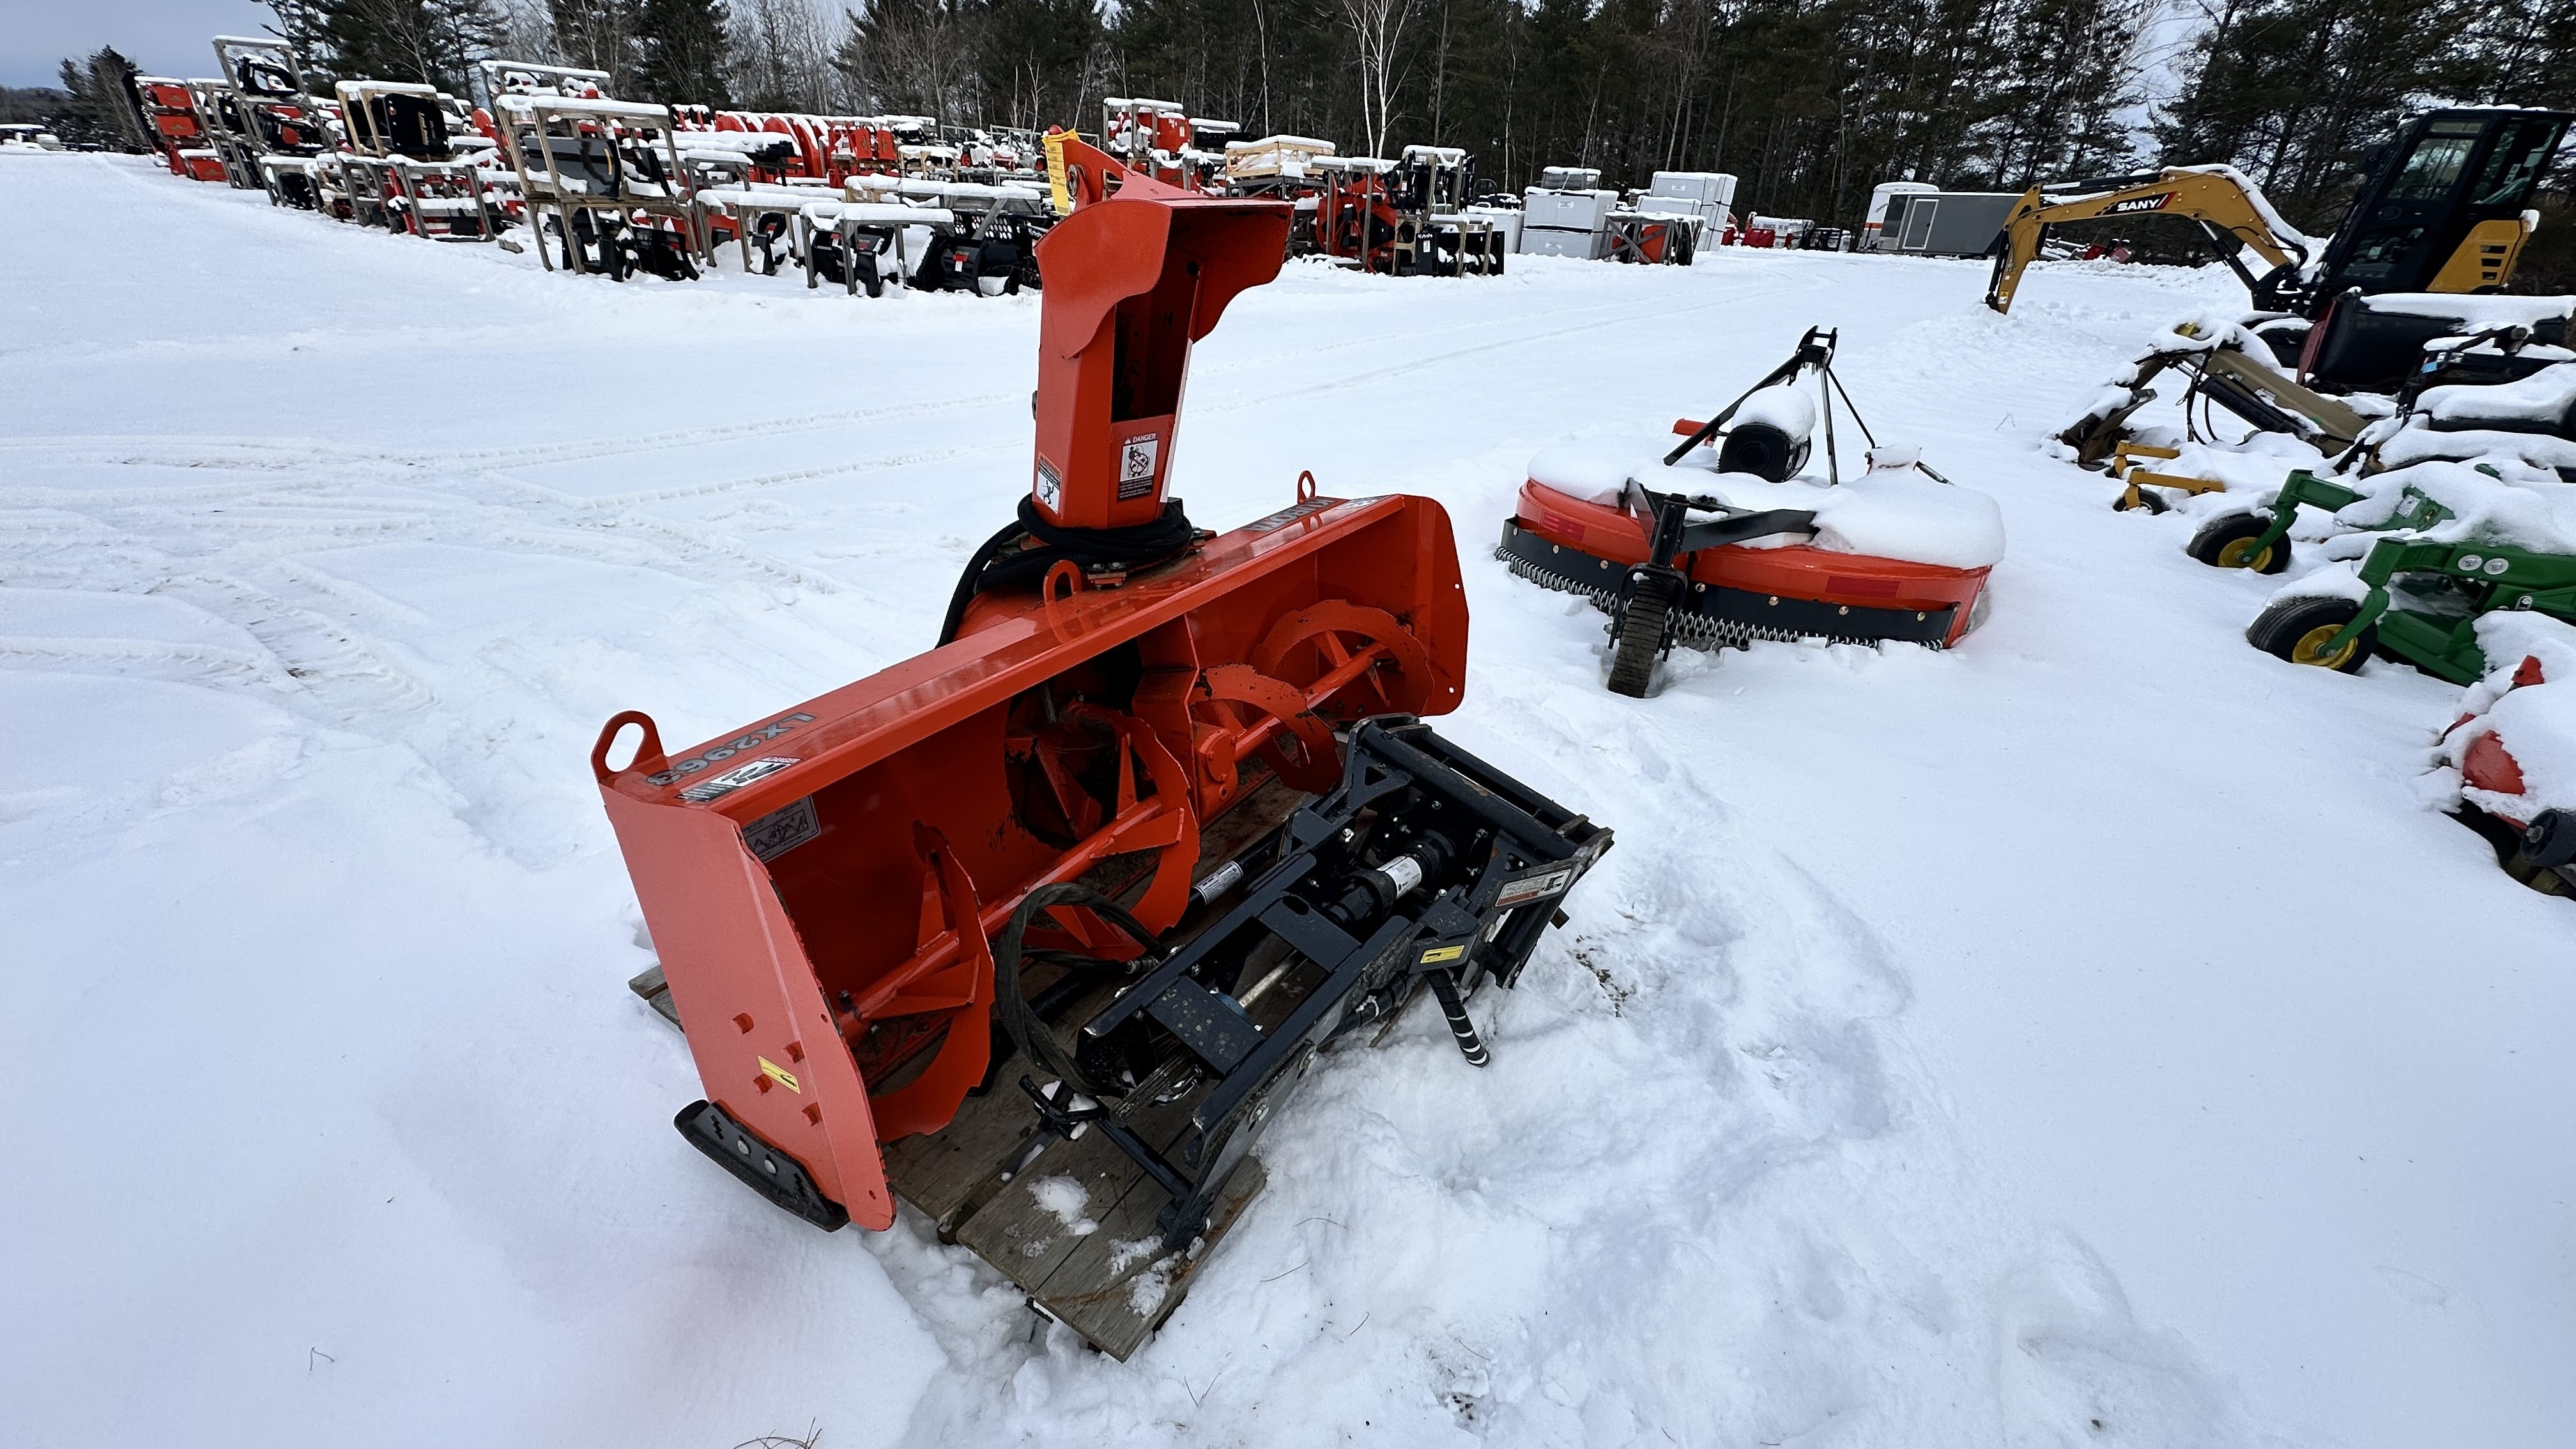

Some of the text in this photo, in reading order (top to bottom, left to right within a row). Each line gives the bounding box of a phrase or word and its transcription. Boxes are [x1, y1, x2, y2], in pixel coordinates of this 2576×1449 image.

[2117, 198, 2160, 211] SANY
[1133, 433, 1156, 443] DANGER
[646, 712, 816, 786] LX2963
